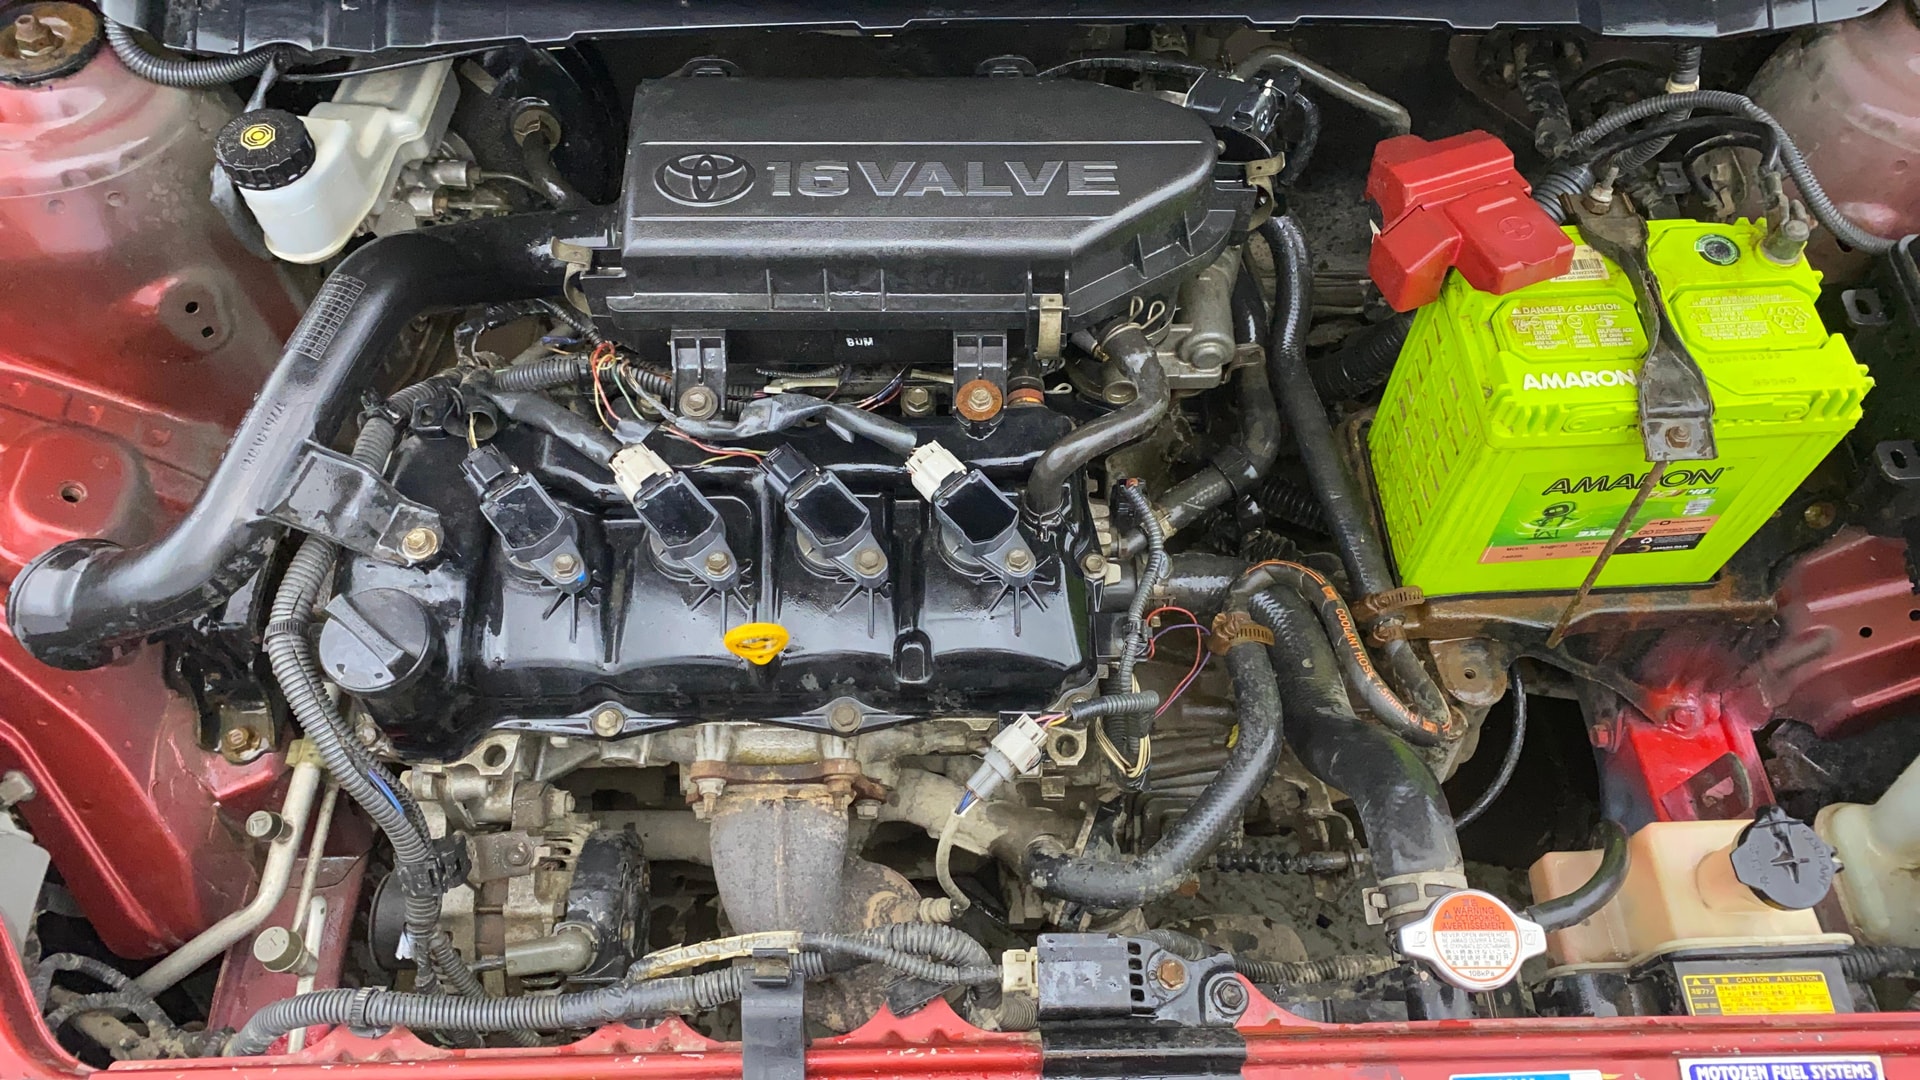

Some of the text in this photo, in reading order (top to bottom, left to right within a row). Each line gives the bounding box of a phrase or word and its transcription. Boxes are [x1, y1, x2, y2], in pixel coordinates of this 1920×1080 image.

[1523, 306, 1565, 314] DANGER
[1575, 303, 1621, 312] CAUTION
[1523, 369, 1638, 391] AMARON
[1336, 608, 1362, 650] COOLANT
[1354, 651, 1377, 681] HOSE
[1453, 906, 1495, 914] WARNING
[1442, 922, 1505, 930] AVERTISSEMENT
[1695, 1064, 1872, 1080] MOTOZEN FUEL SYSTEMS
